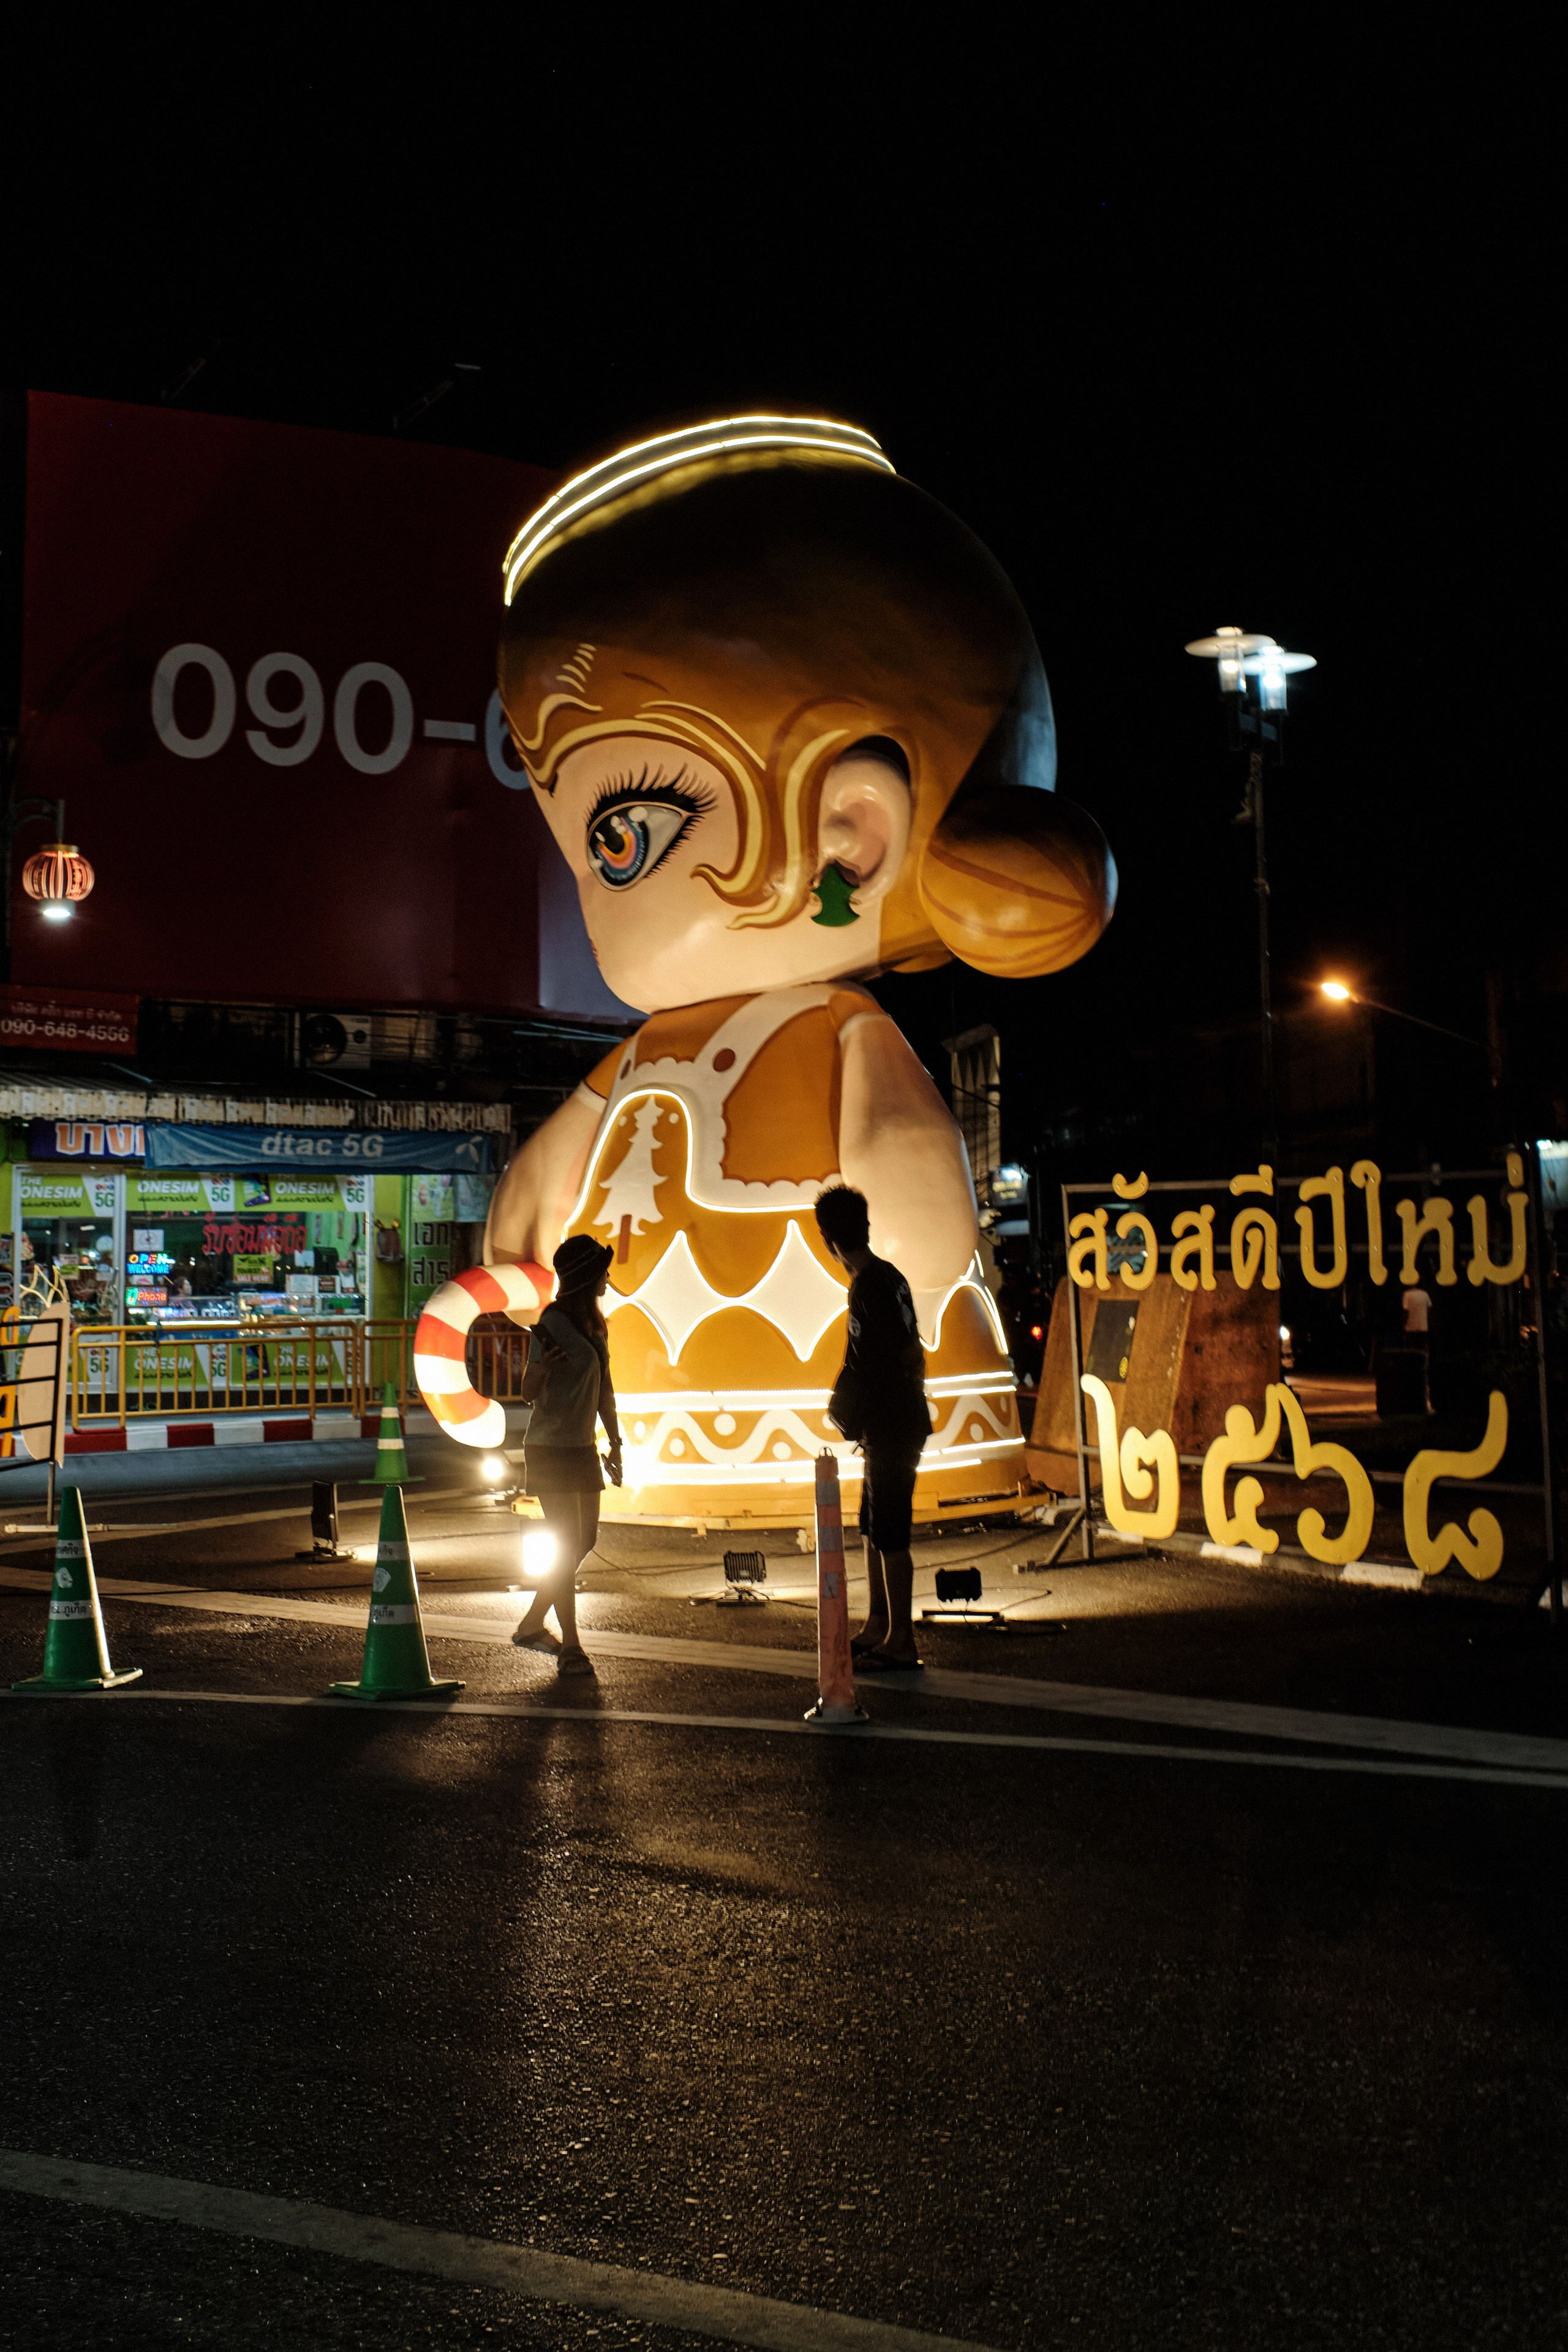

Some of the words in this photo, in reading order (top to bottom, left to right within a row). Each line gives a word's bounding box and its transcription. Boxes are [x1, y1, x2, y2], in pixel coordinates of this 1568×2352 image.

[261, 1132, 331, 1156] dtac
[342, 1134, 384, 1158] 5G
[21, 1186, 83, 1199] ONESIM
[137, 1180, 200, 1194] ONESIM
[275, 1182, 335, 1194] ONESIM
[95, 1192, 115, 1207] 5G
[211, 1187, 230, 1202] 5G
[347, 1188, 364, 1202] 5G
[1068, 1152, 1529, 1291] สวัสดีปีใหม่
[129, 1254, 168, 1264] OPEN
[137, 1291, 167, 1302] Phone
[1081, 1374, 1509, 1580] ๒๕๖๘
